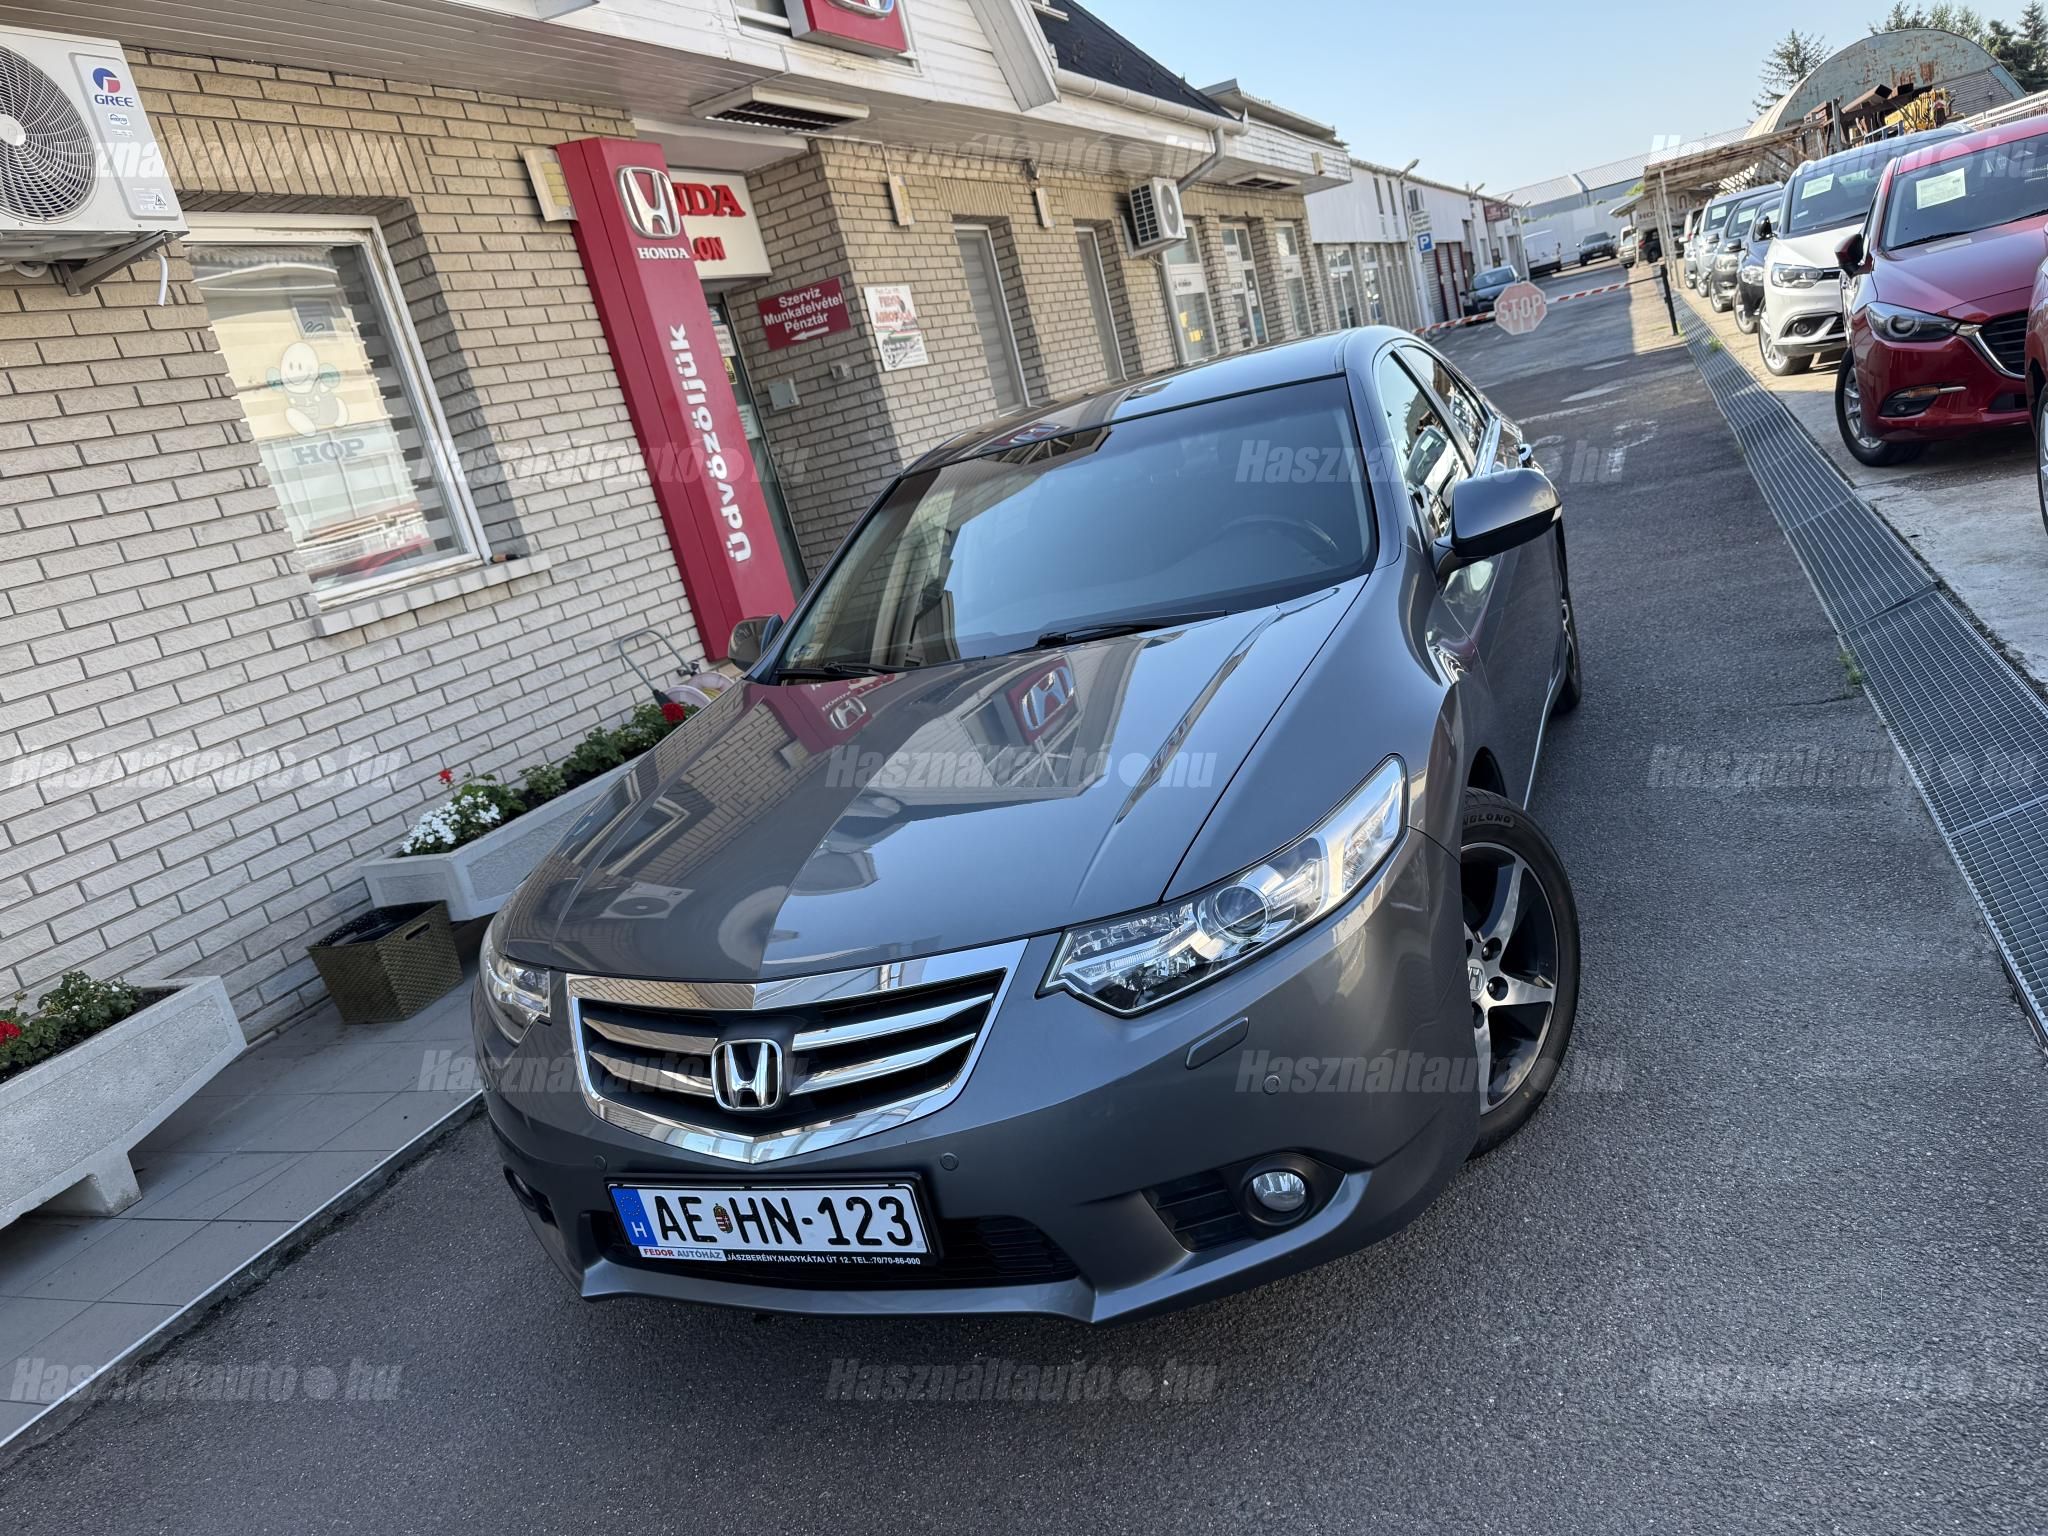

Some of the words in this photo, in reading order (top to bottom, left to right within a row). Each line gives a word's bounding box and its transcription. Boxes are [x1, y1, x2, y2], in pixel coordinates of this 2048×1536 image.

[94, 94, 135, 108] GREE
[637, 247, 690, 260] HONDA
[779, 287, 822, 309] Szerviz
[1500, 294, 1542, 322] STOP
[763, 293, 844, 327] Munkafelvétel
[784, 312, 829, 334] Pénztár
[291, 438, 365, 466] HOP
[670, 323, 752, 563] Üdvözöljük
[631, 1221, 648, 1238] H
[654, 1195, 718, 1243] AE
[728, 1196, 914, 1247] HN-123
[643, 1248, 675, 1257] FEDOR
[677, 1248, 723, 1260] AUTÓHÁZ
[826, 1254, 837, 1264] ÚT
